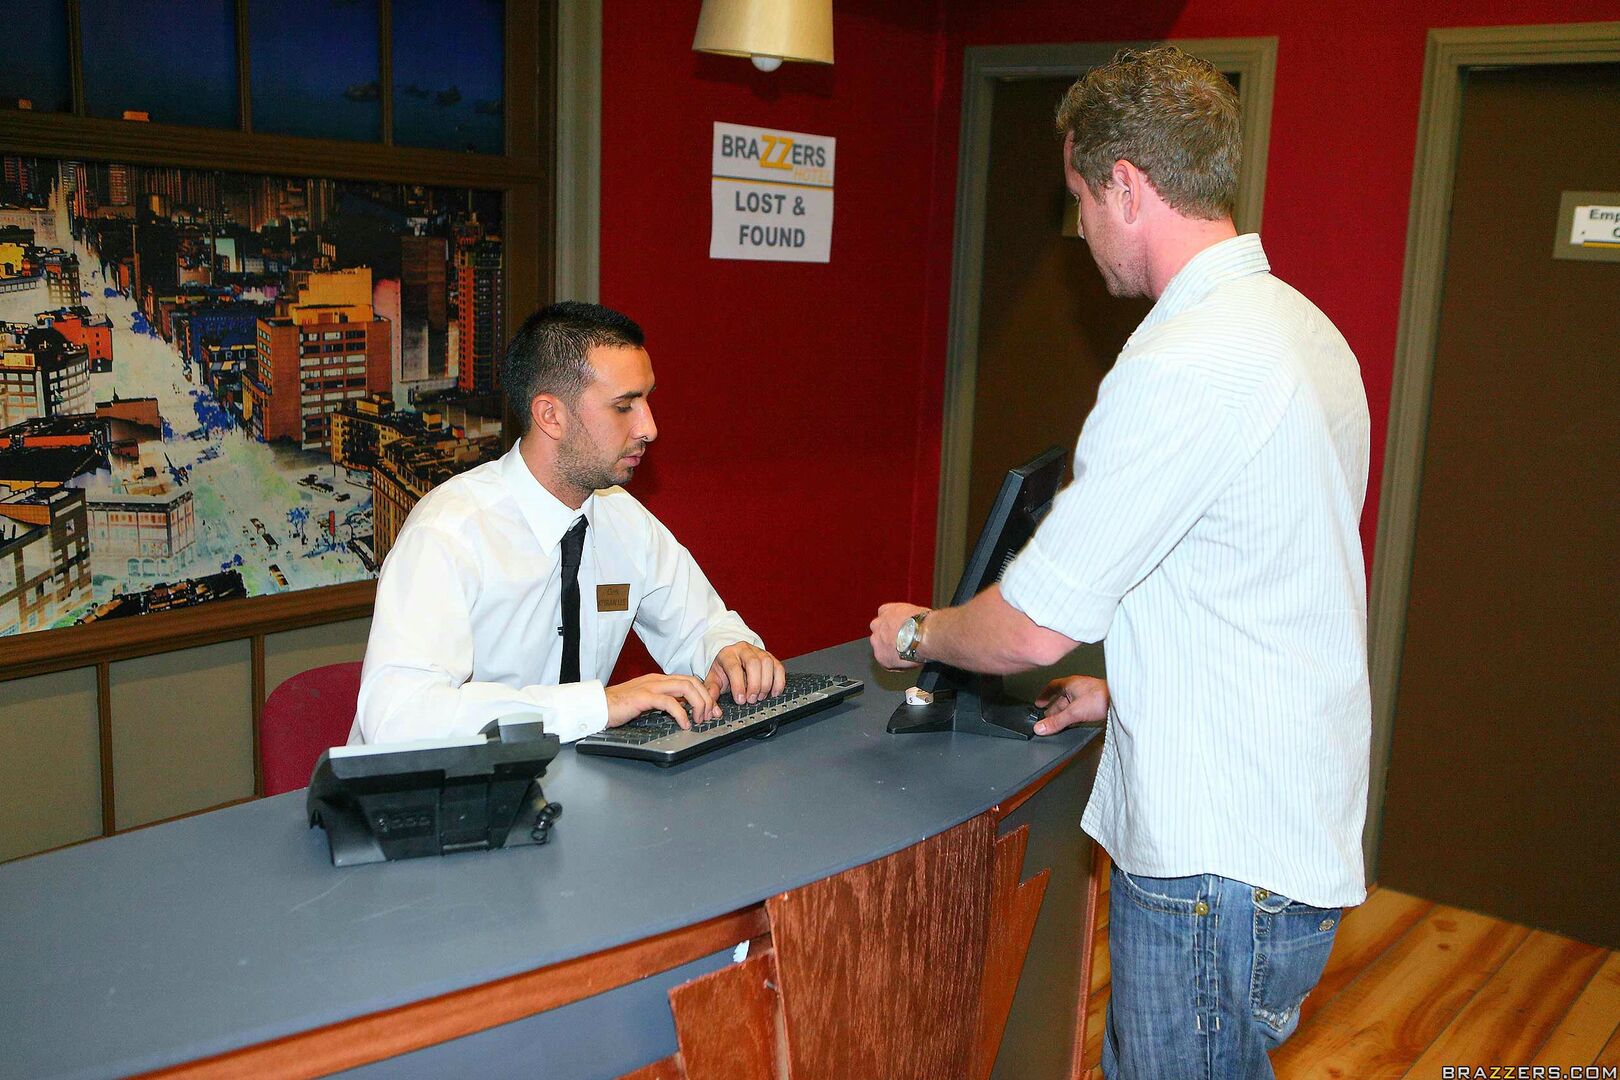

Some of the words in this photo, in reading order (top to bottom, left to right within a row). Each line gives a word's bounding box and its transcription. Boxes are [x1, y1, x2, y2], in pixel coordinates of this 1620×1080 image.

[722, 133, 825, 170] BRAZZERS
[735, 191, 786, 215] LOST
[792, 195, 805, 216] &
[739, 224, 805, 248] FOUND
